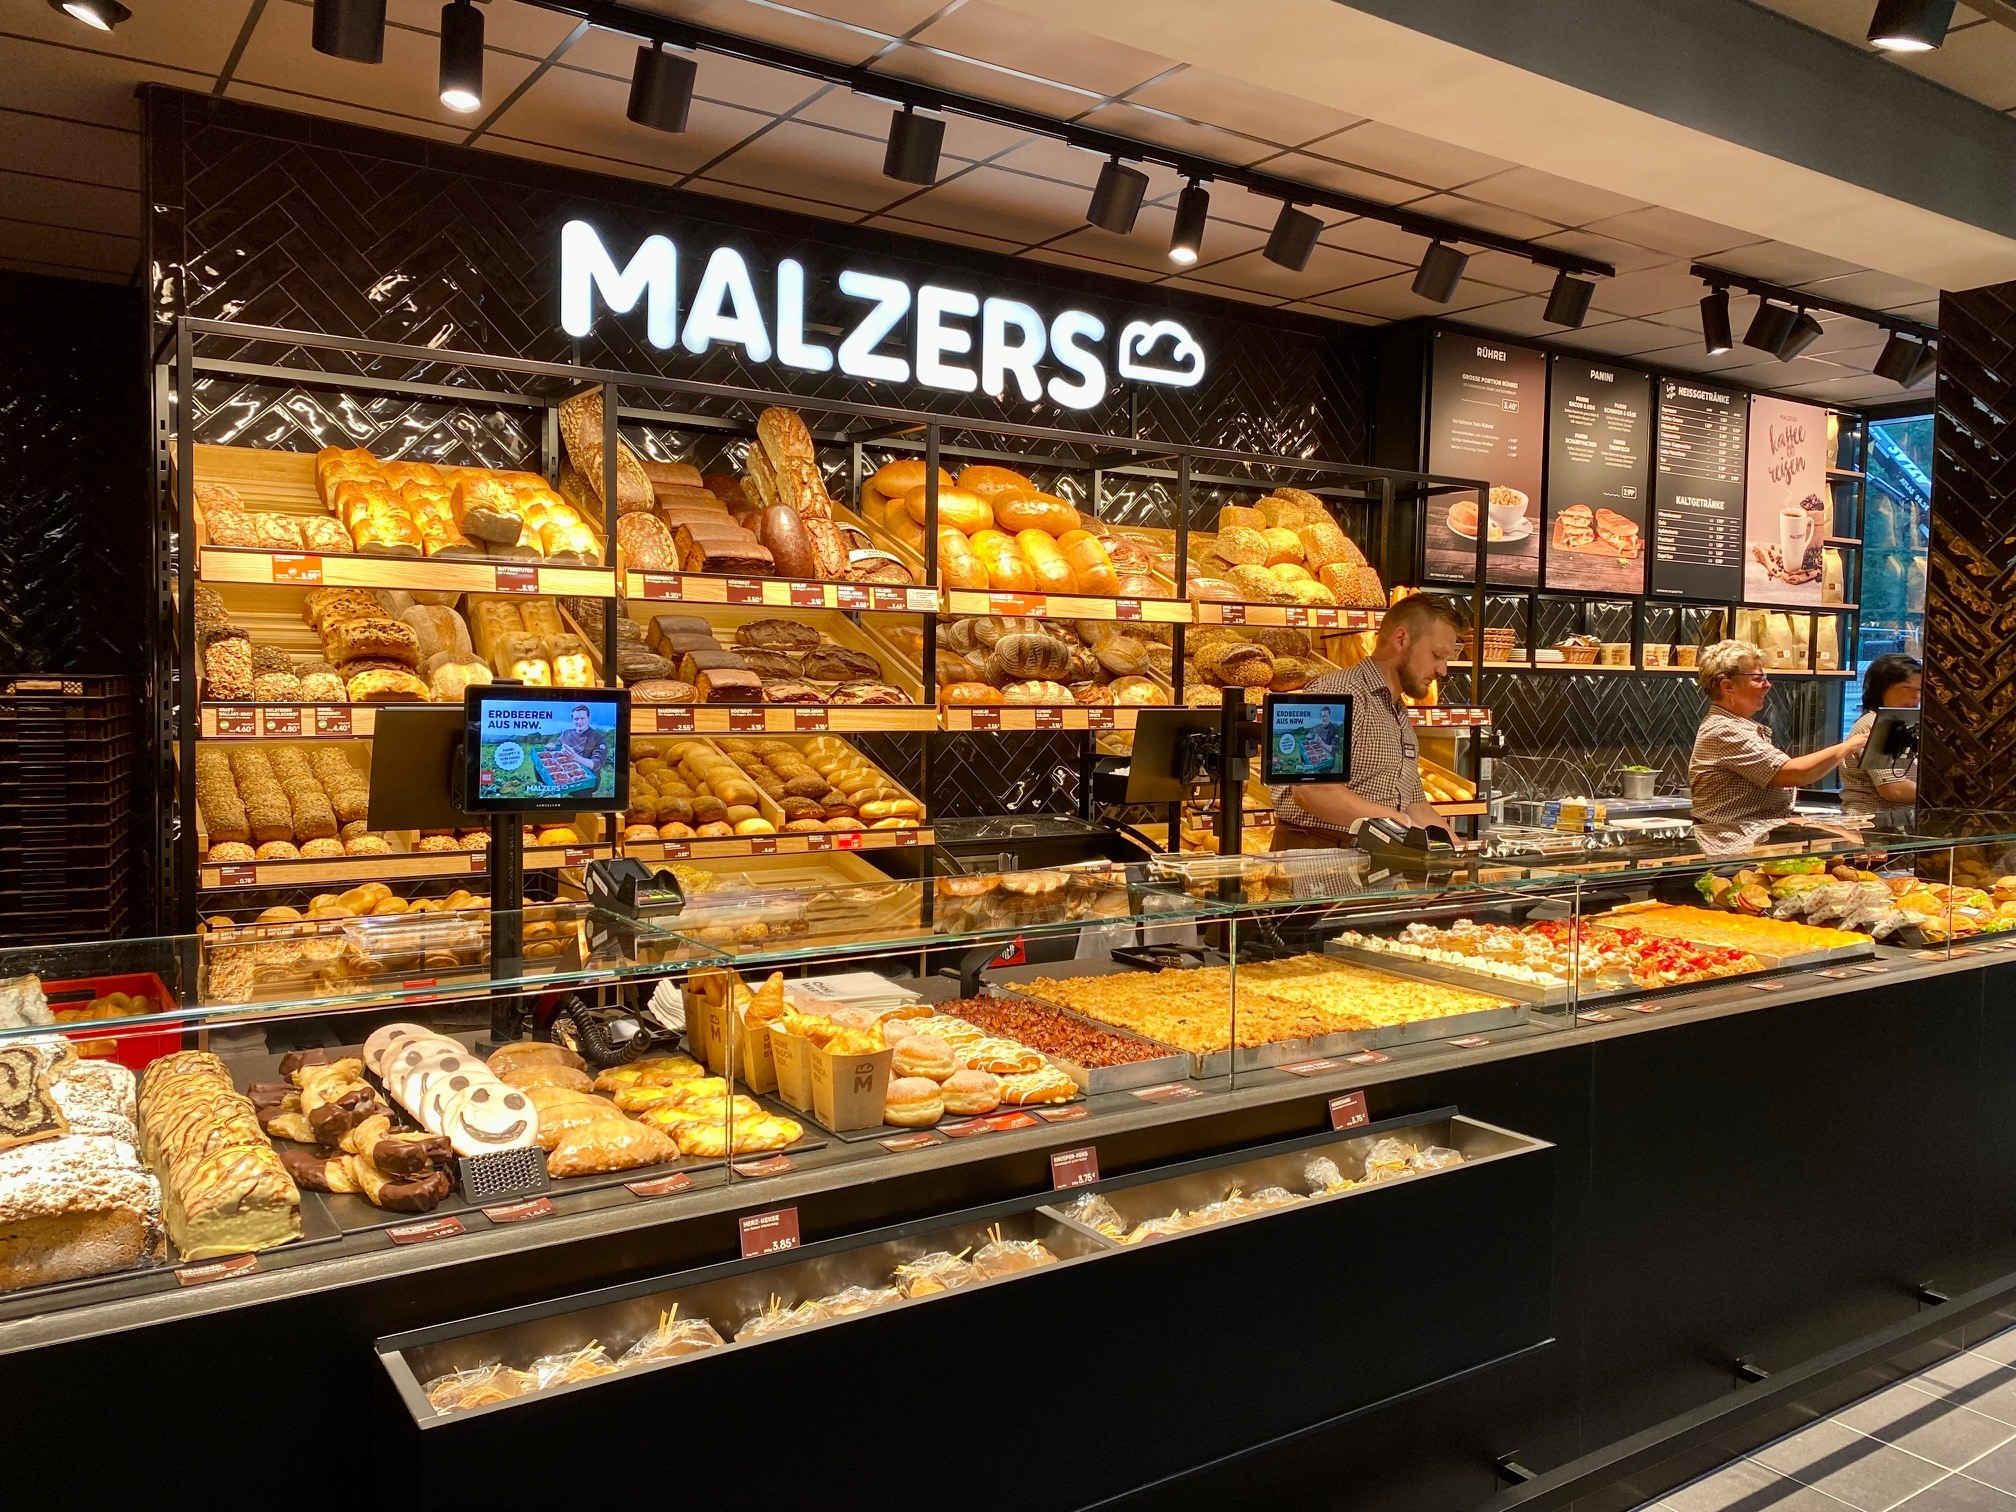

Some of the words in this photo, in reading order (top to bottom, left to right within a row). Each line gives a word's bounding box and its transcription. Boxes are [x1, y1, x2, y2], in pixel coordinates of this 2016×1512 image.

[561, 219, 1107, 410] MALZERS
[1476, 346, 1507, 362] RÜHREI
[1590, 369, 1614, 383] PANINI
[1678, 386, 1730, 404] HEISSGETRÄNKE
[1675, 495, 1725, 510] KALTGETRÄNKE
[488, 710, 553, 719] ERDBEEREN
[488, 720, 510, 729] AUS
[513, 721, 542, 730] NRW.
